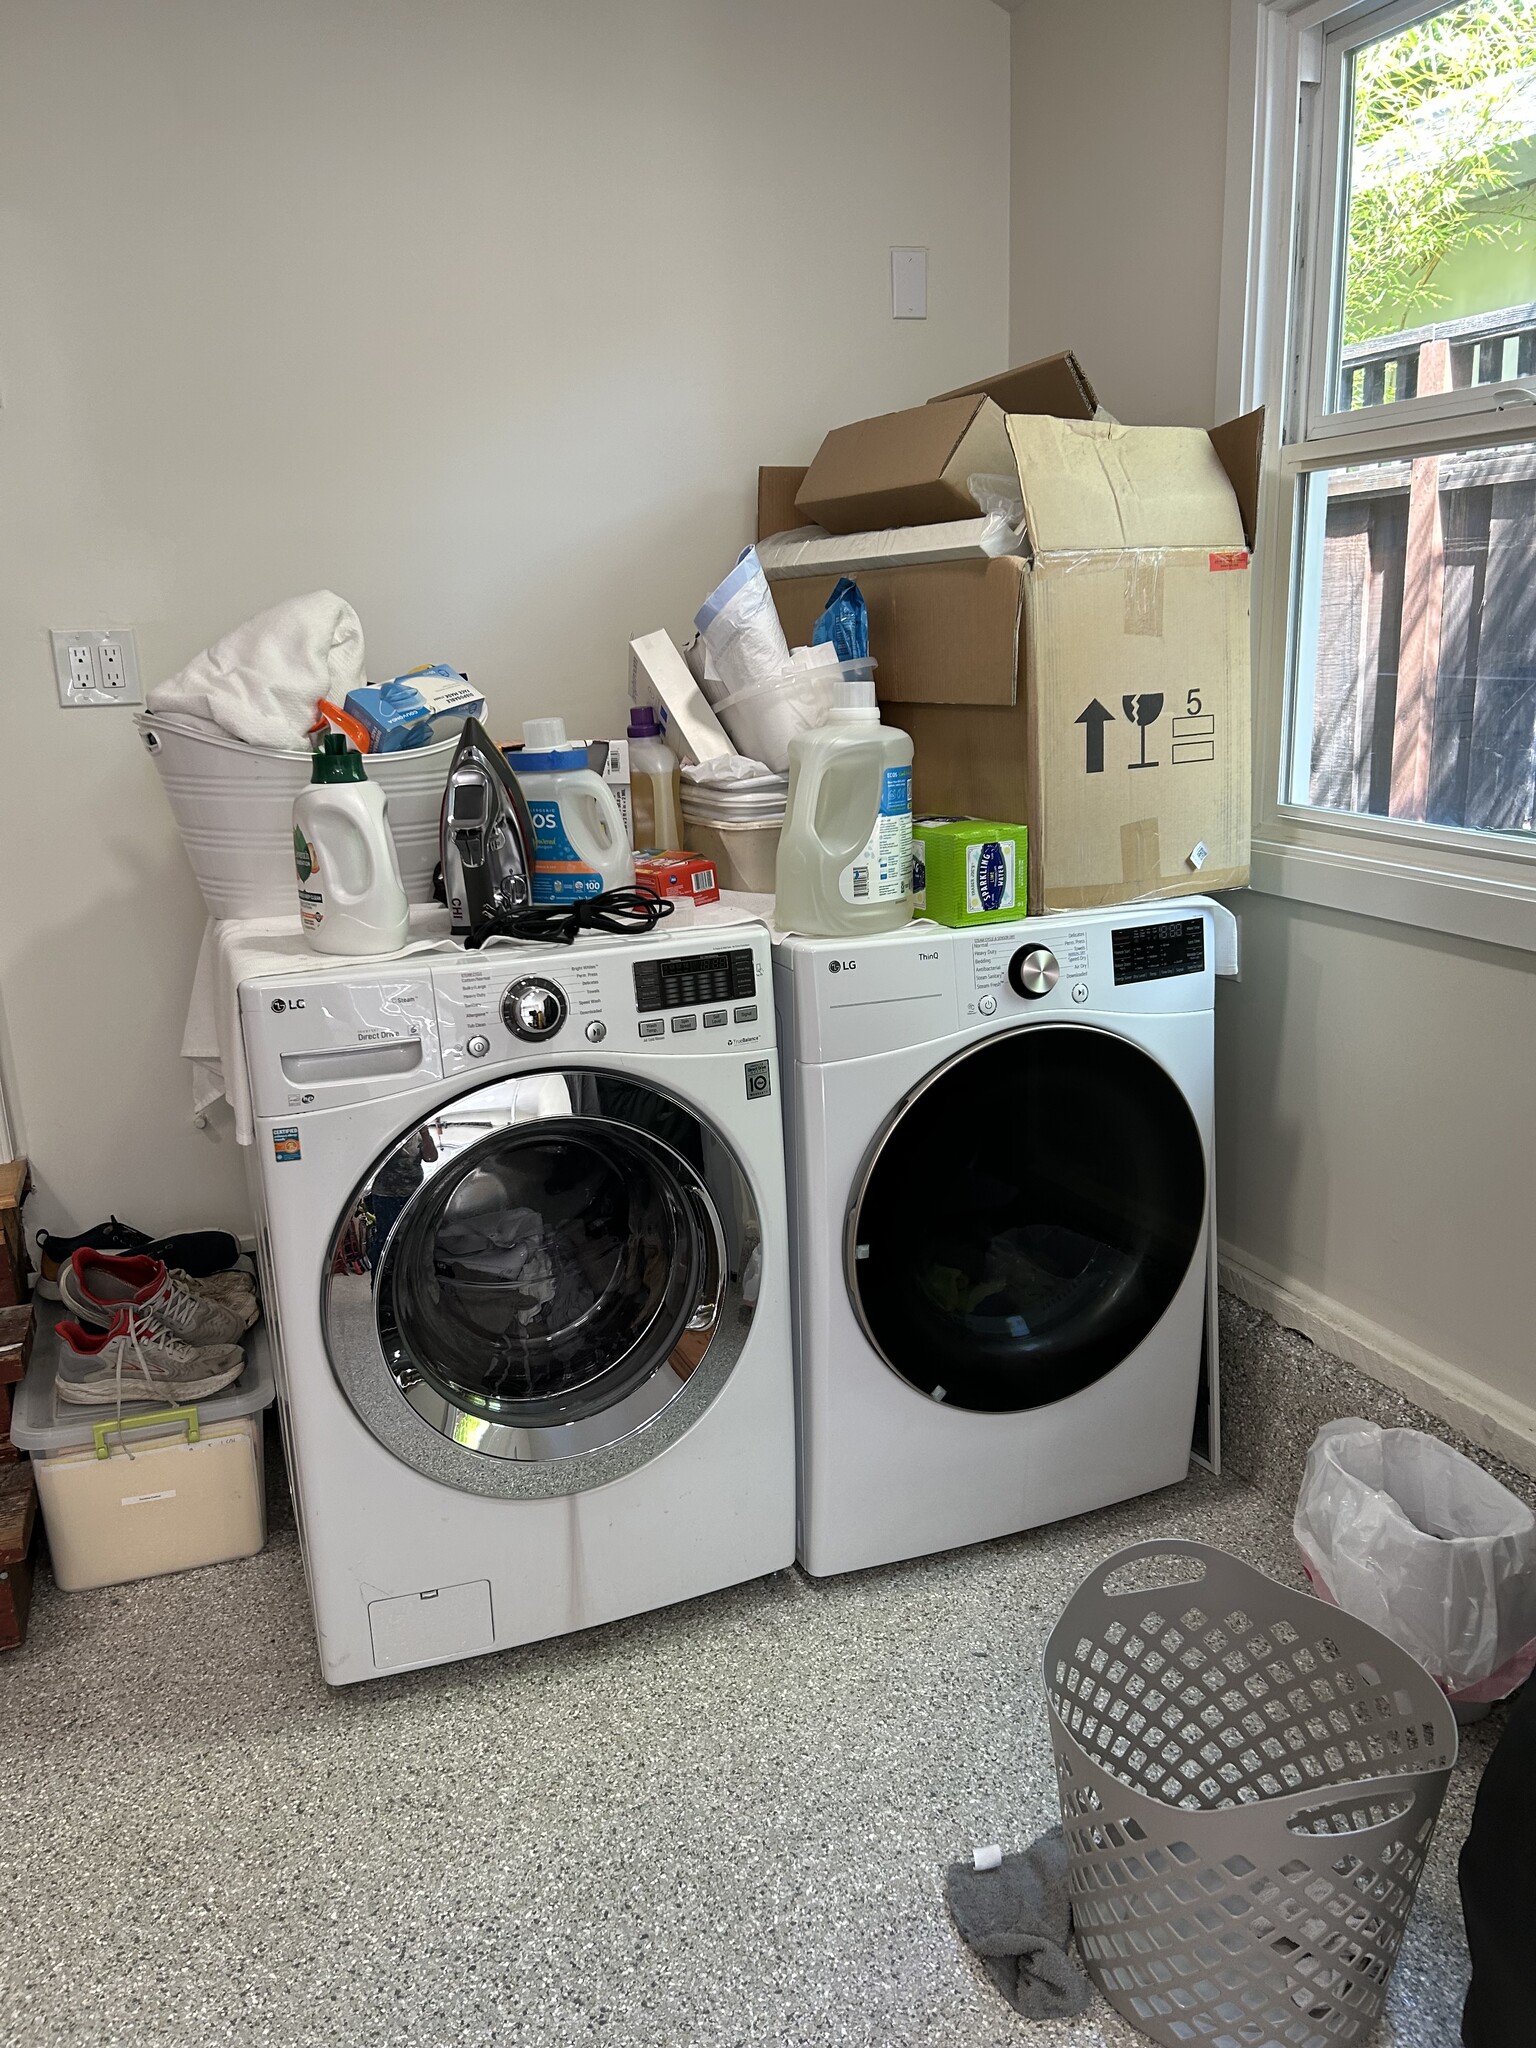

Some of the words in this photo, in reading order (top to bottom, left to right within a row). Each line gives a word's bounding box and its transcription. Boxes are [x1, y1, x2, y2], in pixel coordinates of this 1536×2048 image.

[1187, 688, 1202, 715] 5
[533, 813, 556, 829] OS
[980, 853, 991, 901] SPARKLING
[585, 882, 600, 890] 100
[452, 898, 463, 919] CHI
[919, 952, 939, 960] ThinQ
[843, 961, 856, 970] LG
[289, 999, 305, 1009] LG
[358, 1032, 379, 1040] Direct
[733, 1036, 759, 1044] TrueBalance
[749, 1075, 767, 1092] 10
